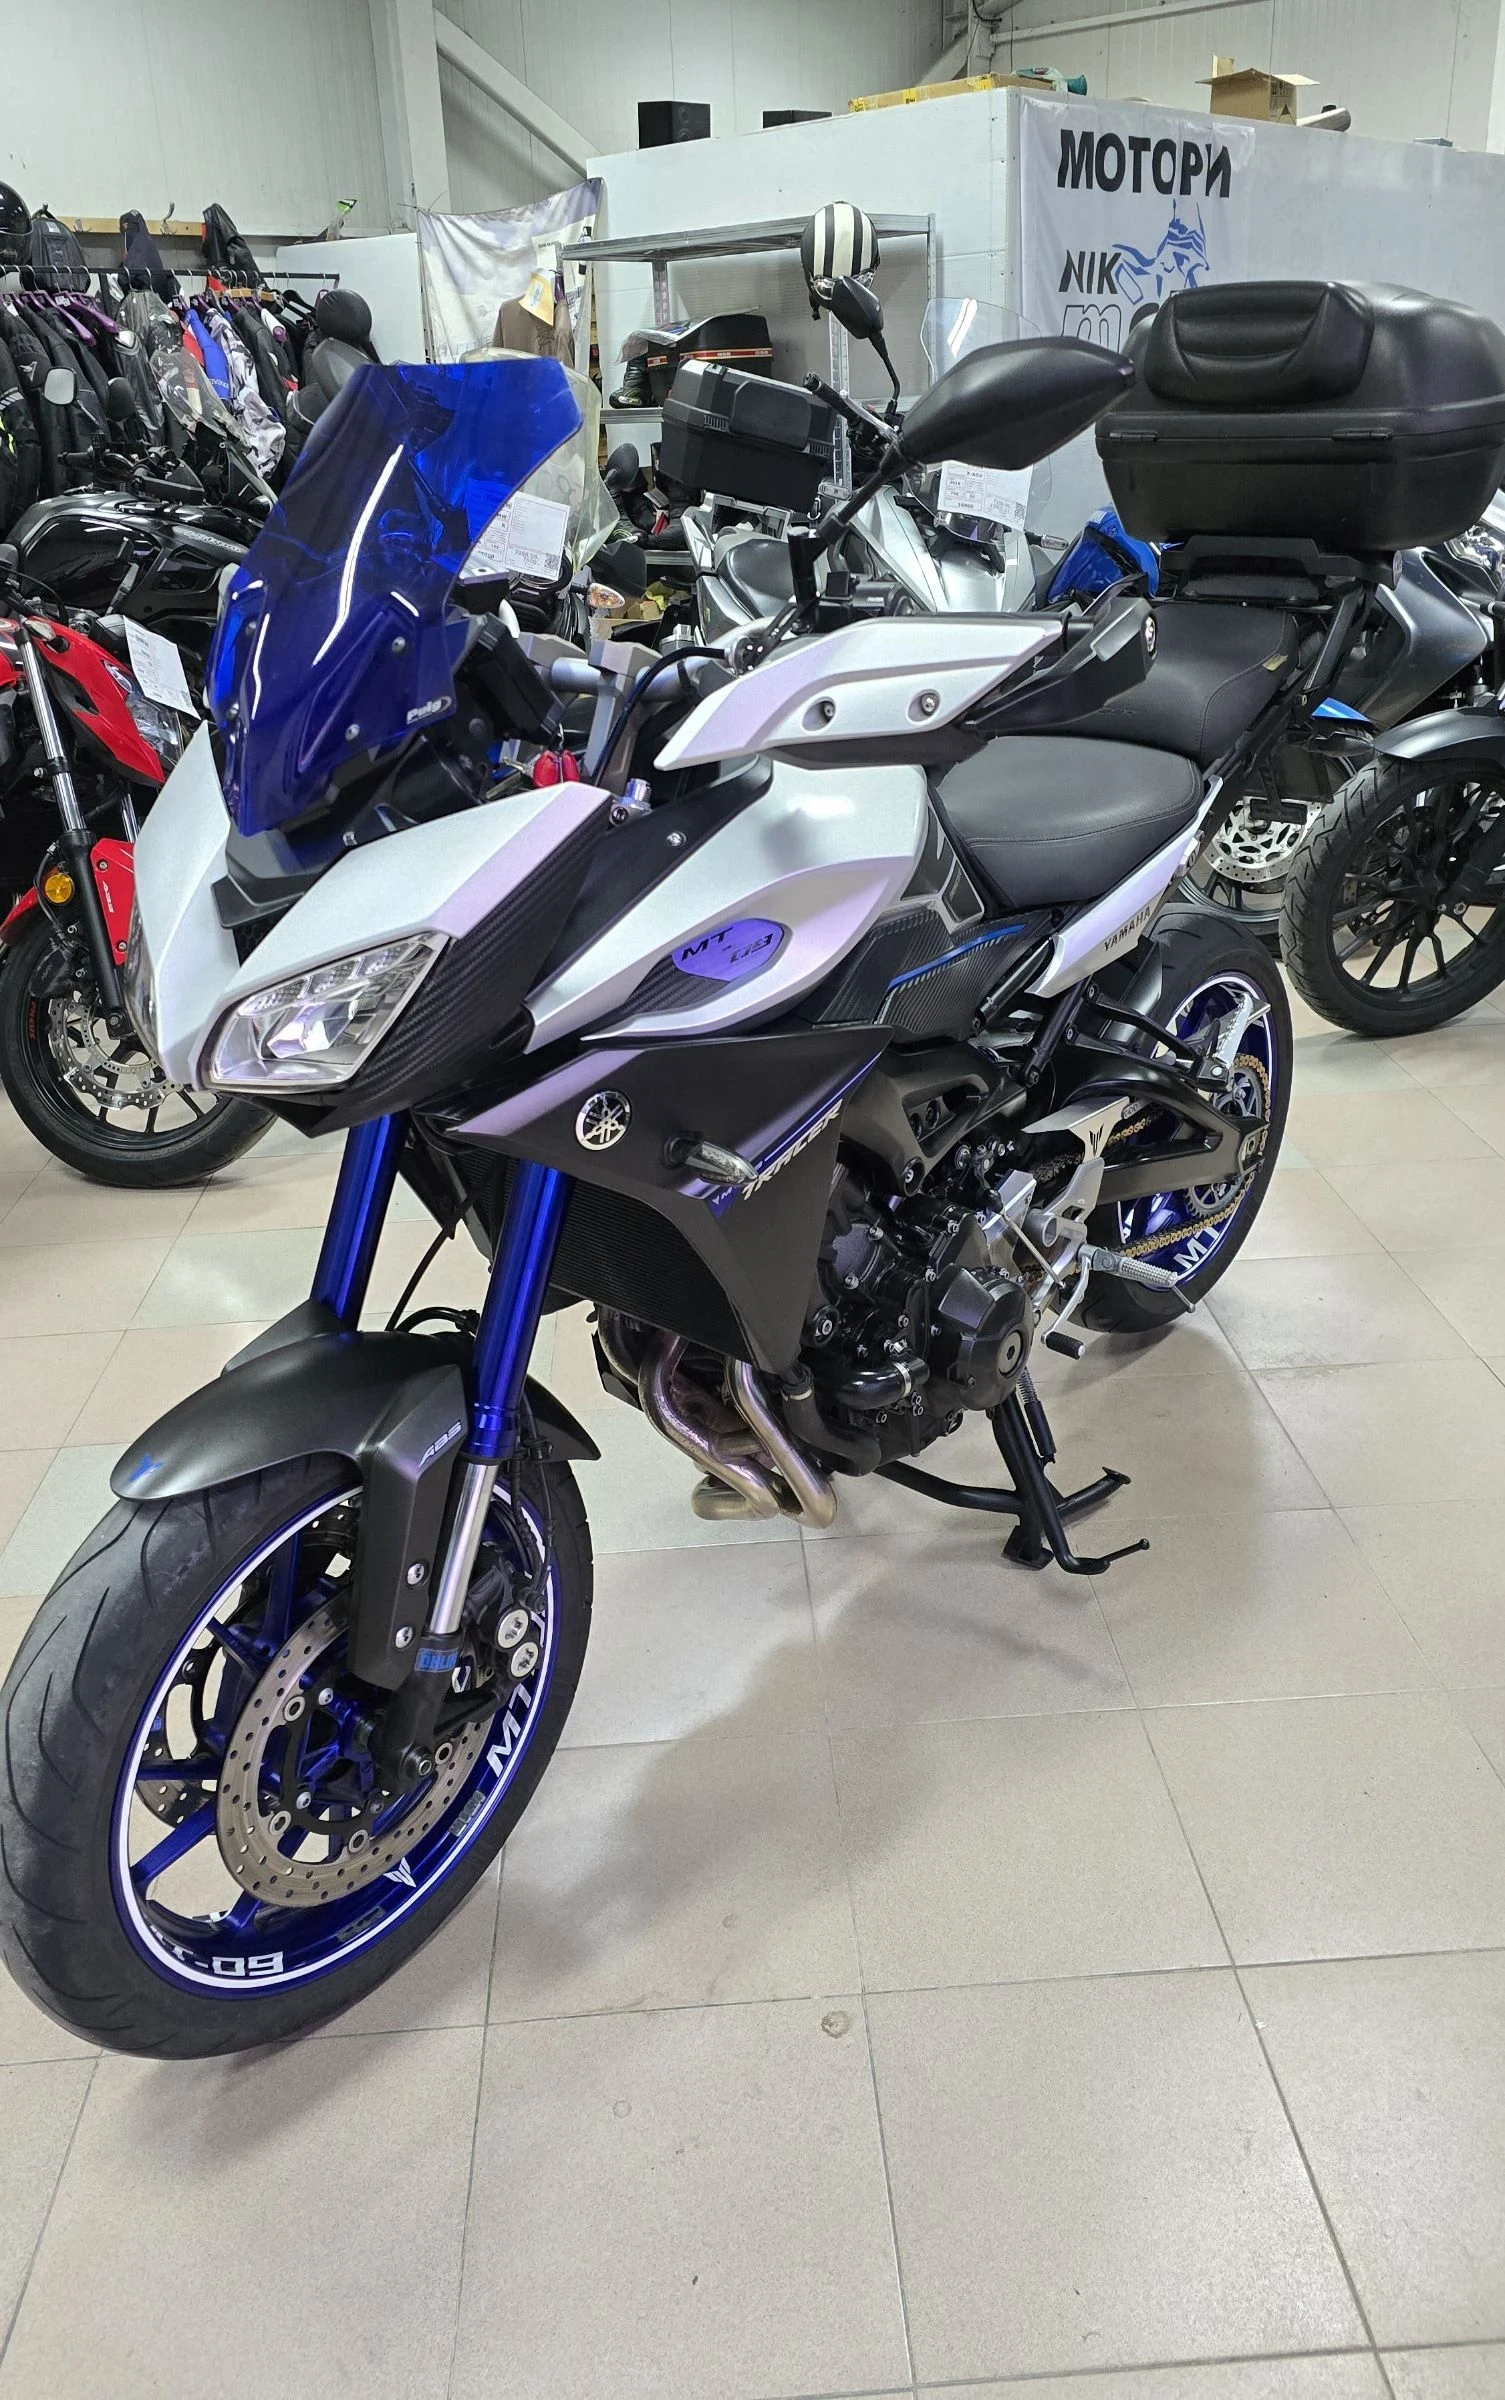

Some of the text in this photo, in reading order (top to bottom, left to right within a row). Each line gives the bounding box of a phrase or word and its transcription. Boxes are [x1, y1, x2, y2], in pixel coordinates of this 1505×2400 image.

[1057, 128, 1232, 198] МОТОРИ
[1058, 250, 1122, 295] NIK
[680, 926, 734, 961] MT
[1104, 906, 1151, 951] YAMAHA
[742, 1098, 843, 1201] TRACER
[418, 1421, 462, 1468] ABS
